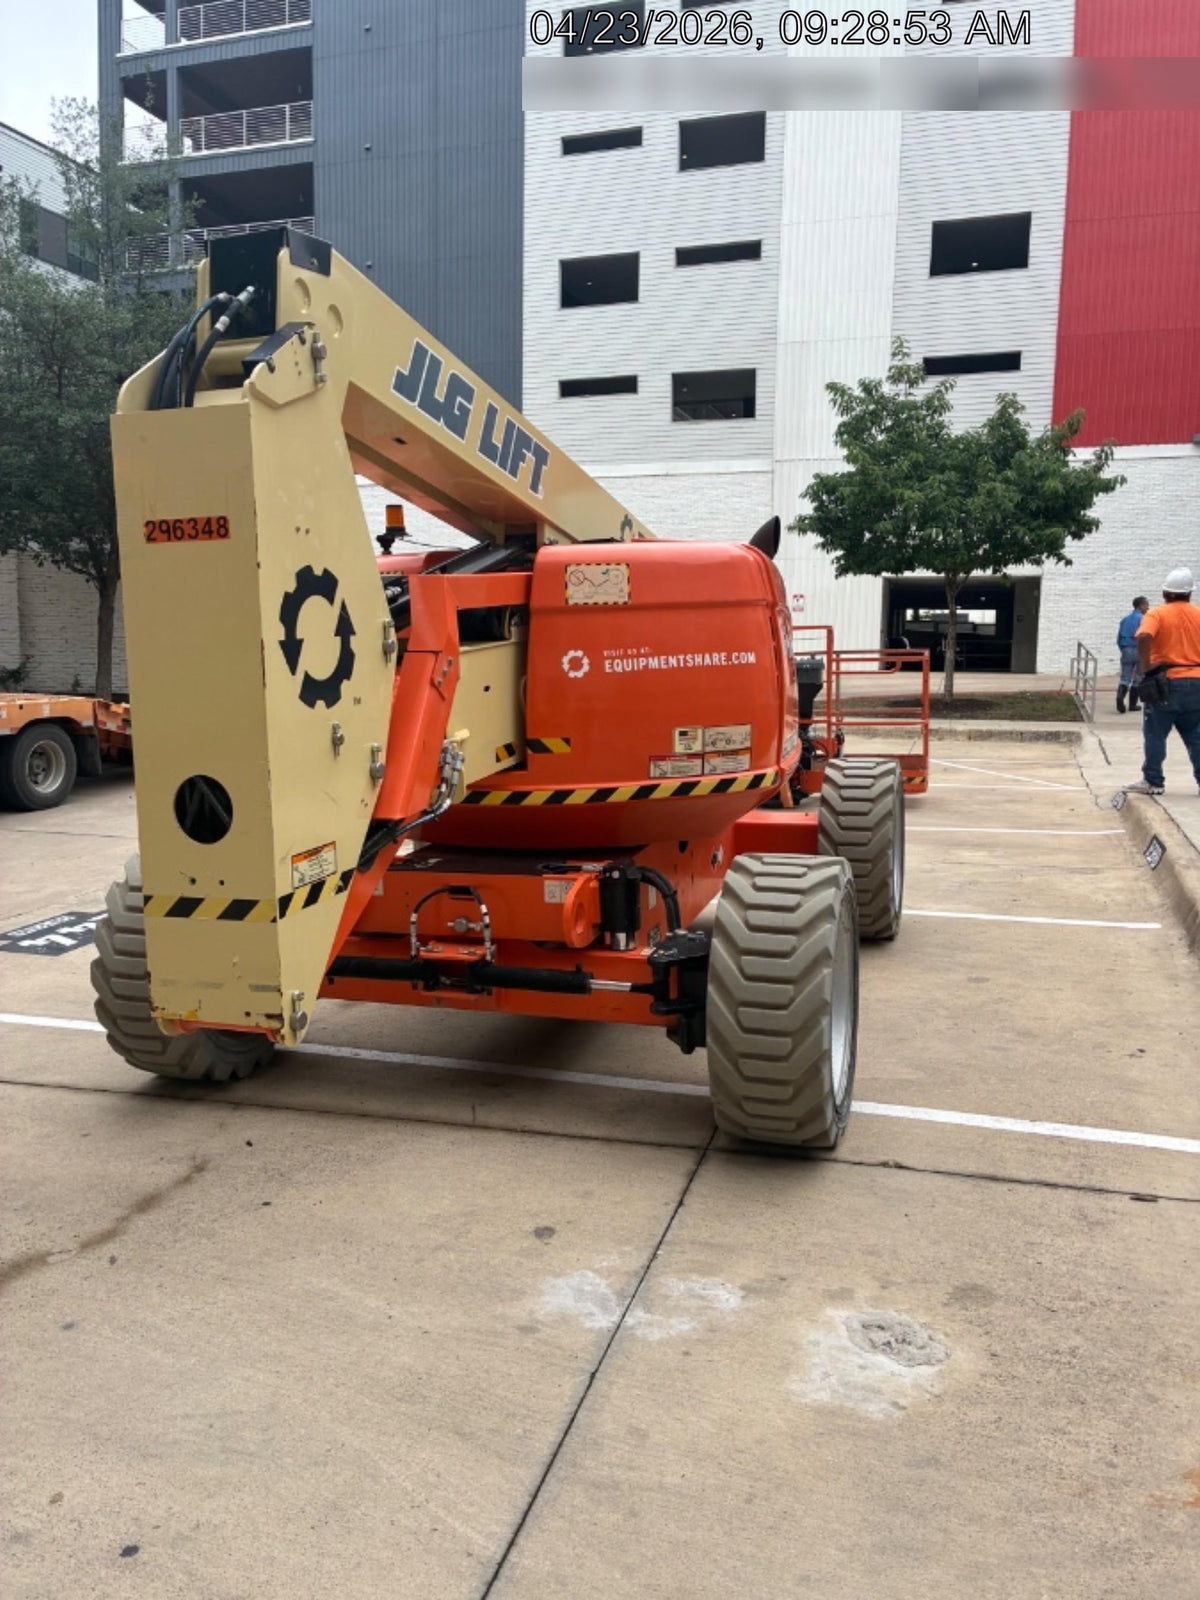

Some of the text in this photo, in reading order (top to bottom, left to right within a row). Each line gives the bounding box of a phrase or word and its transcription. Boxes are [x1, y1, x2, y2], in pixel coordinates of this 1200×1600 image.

[391, 337, 551, 500] JLG LIFT
[144, 515, 230, 543] 296348
[604, 651, 757, 673] EQUIPMENTSHARE.COM
